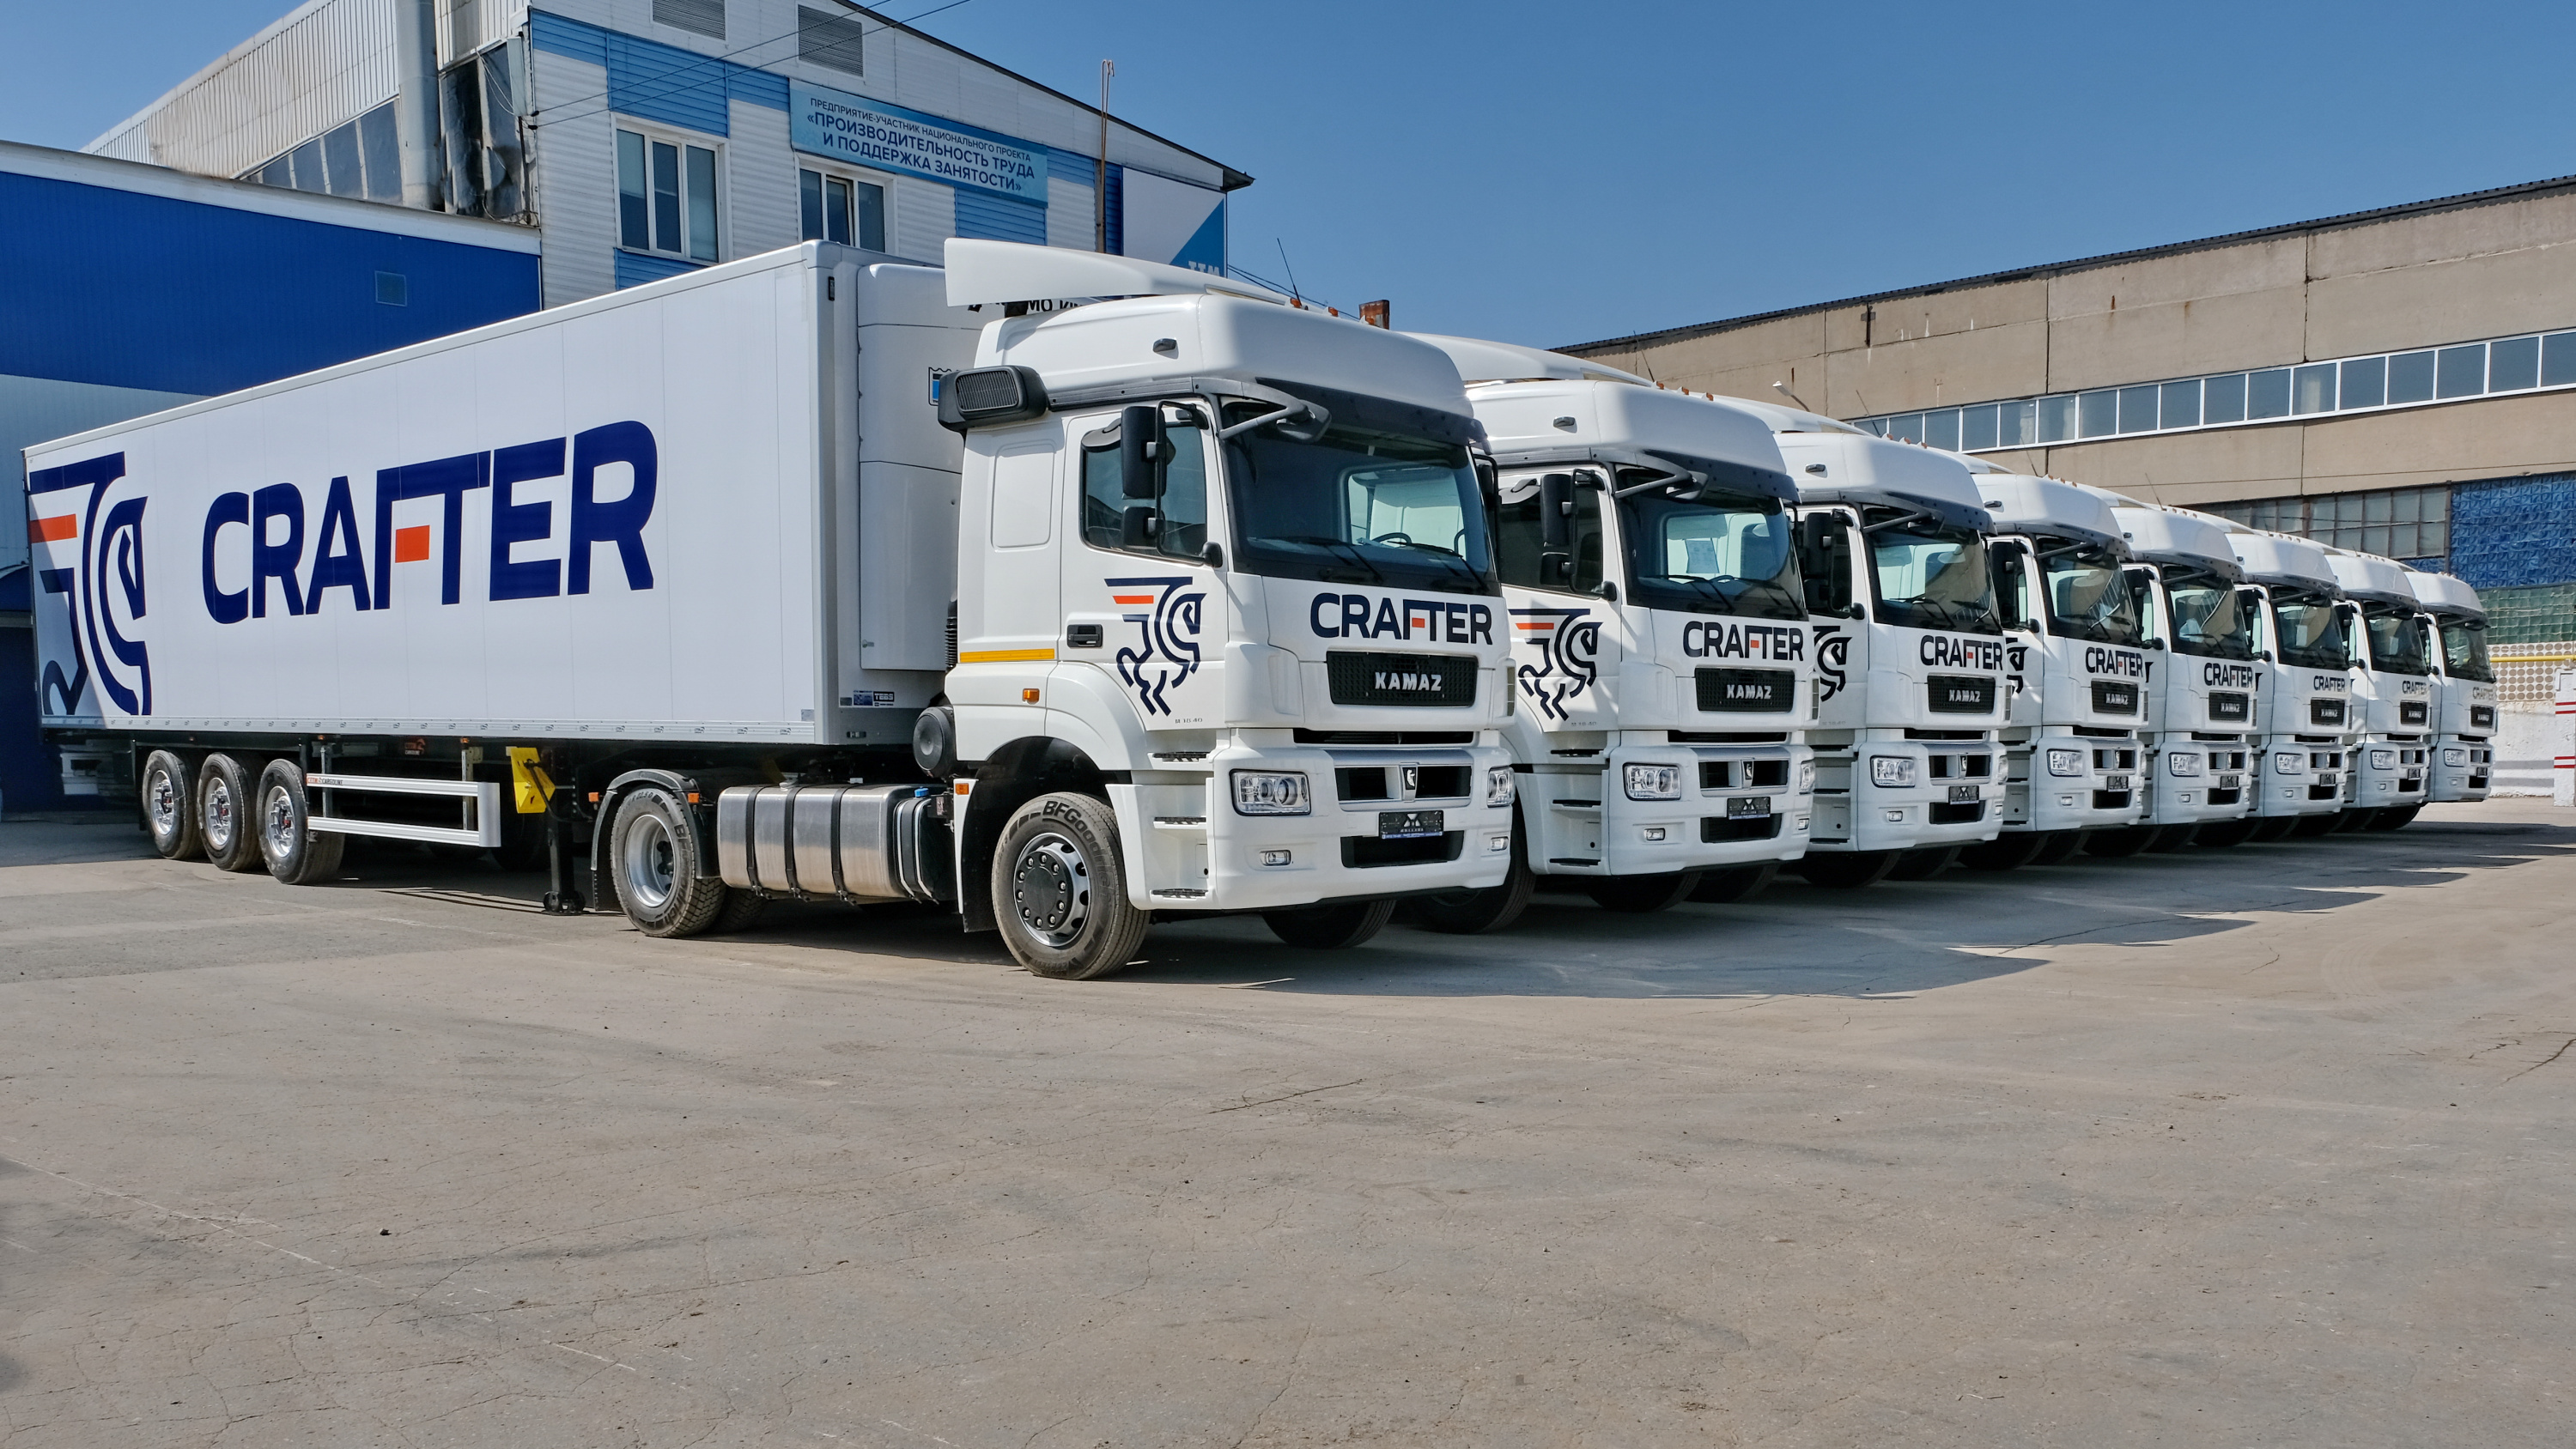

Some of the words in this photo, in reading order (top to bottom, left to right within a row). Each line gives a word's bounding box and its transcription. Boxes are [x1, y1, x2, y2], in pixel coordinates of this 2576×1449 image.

[807, 112, 988, 167] «ПРОИЗВОДИТЕЛЬНОСТЬ
[993, 156, 1035, 179] ТРУДА
[811, 98, 920, 133] ПРЕДПРИЯТИЕ-УЧАСТНИК
[921, 126, 994, 152] НАЦИОНАЛЬНОГО
[996, 144, 1031, 162] ПРОЕКТА
[823, 131, 834, 147] И
[838, 136, 931, 171] ПОДДЕРЖКА
[935, 160, 1022, 191] ЗАНЯТОСТИ»
[203, 421, 658, 624] CRAFTER
[1310, 592, 1492, 645] CRAFTER
[1683, 621, 1803, 661] CRAFTER
[1920, 635, 2002, 670] CRAFTER
[2086, 646, 2143, 677] CRAFTER
[2204, 663, 2252, 688] CRAFTER
[1375, 671, 1442, 691] KAMAZ
[1727, 684, 1771, 700] KAMAZ
[1948, 689, 1980, 702] KAMAZ
[2314, 676, 2345, 692] CRAFTER
[1042, 800, 1115, 905] BFGoodrich
